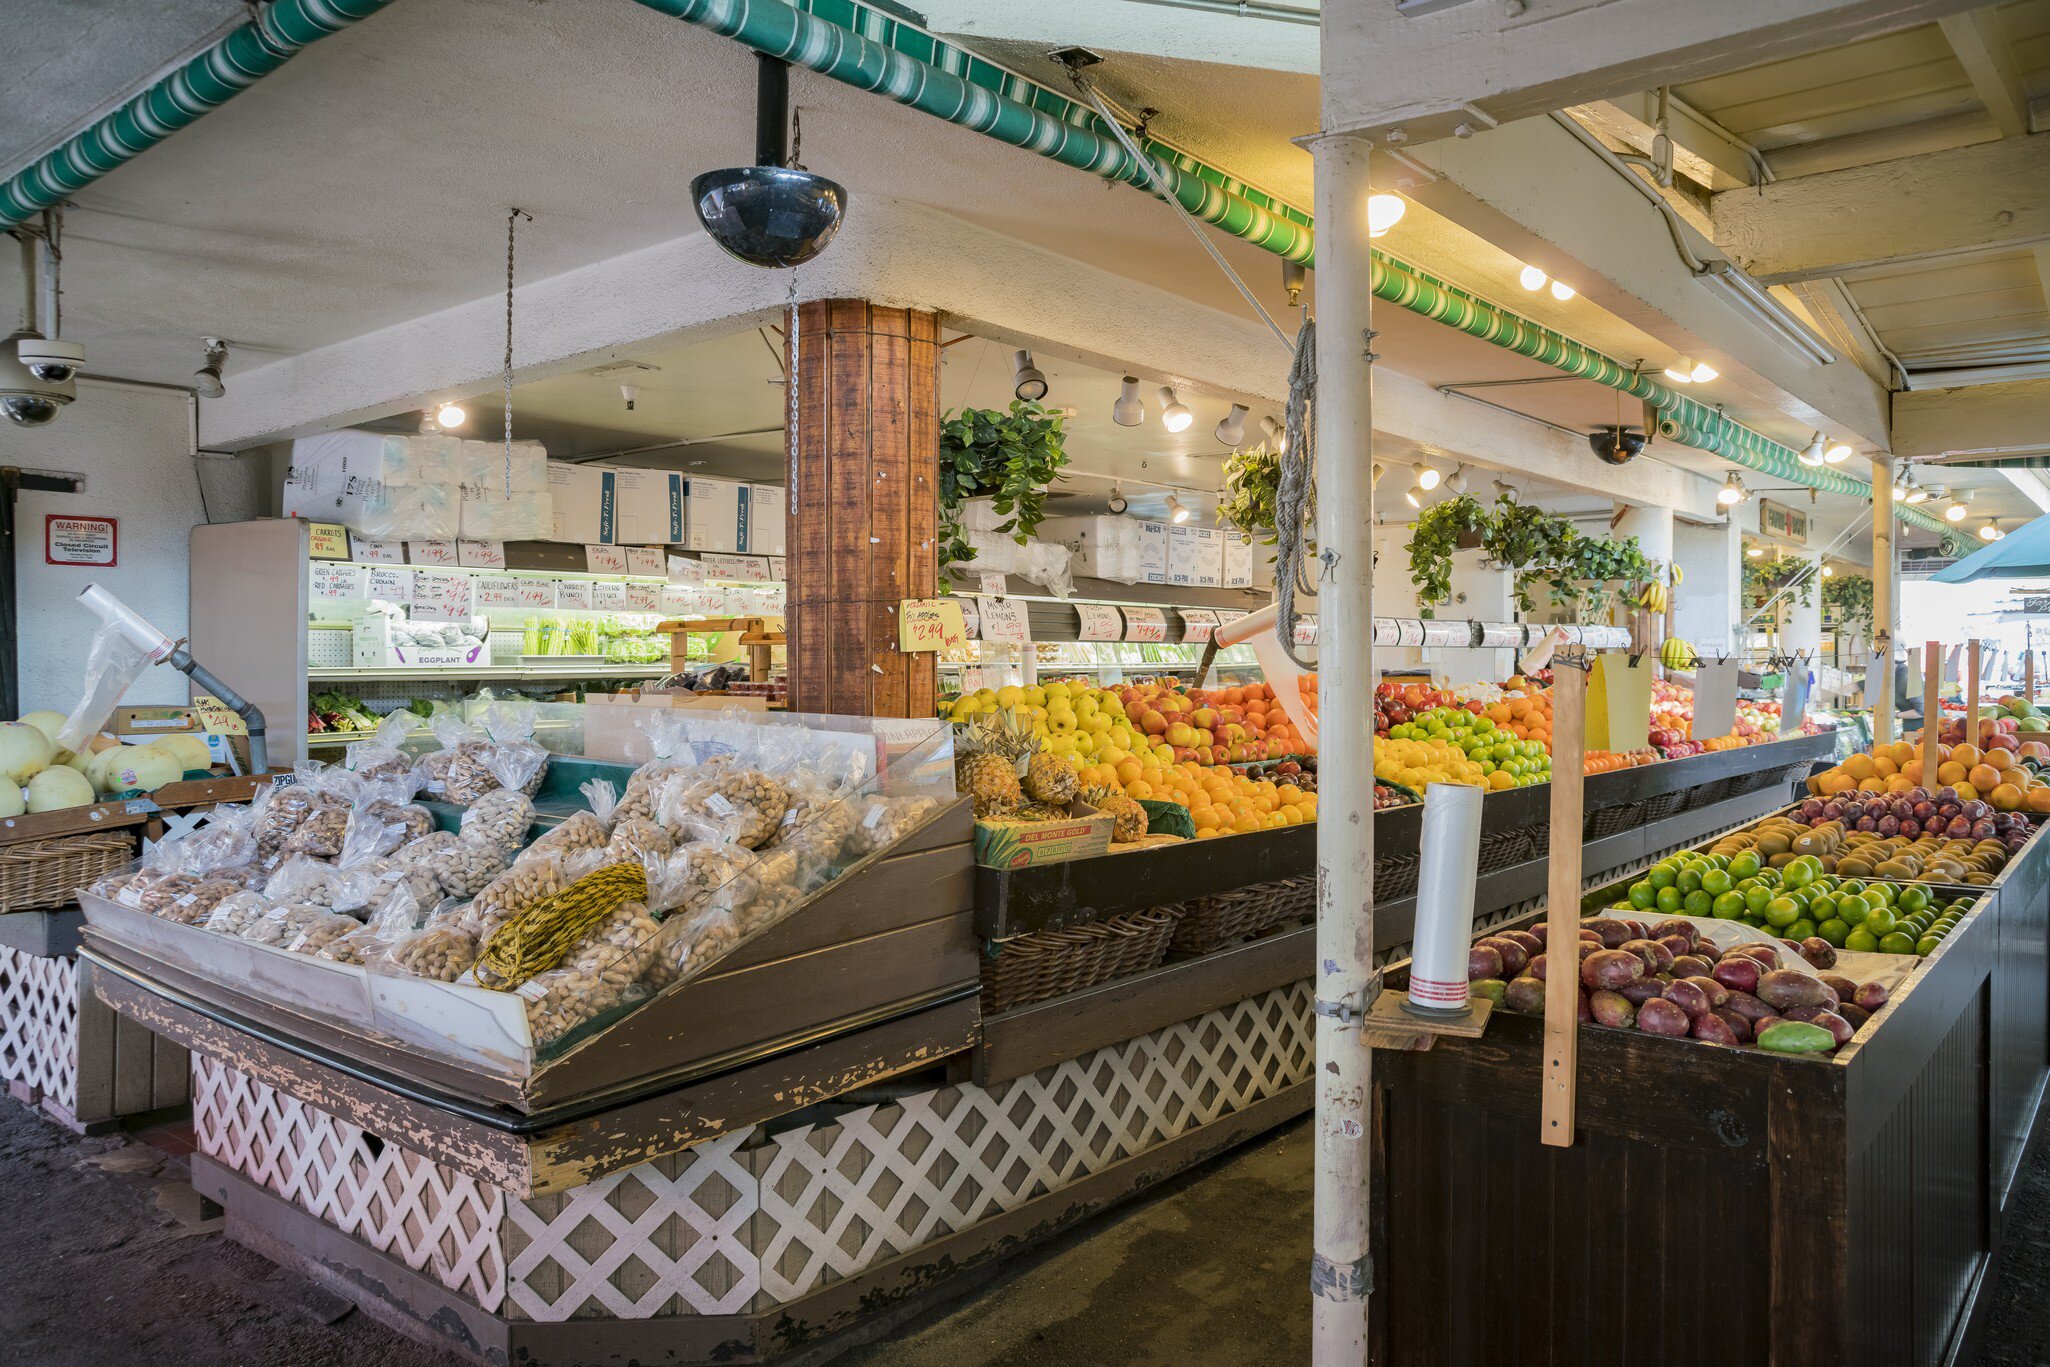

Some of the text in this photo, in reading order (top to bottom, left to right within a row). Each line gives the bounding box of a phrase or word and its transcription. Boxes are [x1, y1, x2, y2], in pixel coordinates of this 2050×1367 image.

[346, 475, 356, 496] 17S
[56, 521, 108, 532] WARNING!
[316, 529, 341, 537] CARROTS
[314, 568, 356, 577] GREEN CABBAGES
[477, 580, 518, 590] CAULIFLOWERS
[558, 583, 586, 591] CARROTS
[987, 601, 1012, 611] MEYER
[985, 610, 1017, 621] LEMONS
[1086, 610, 1112, 620] LEMONS
[1040, 830, 1065, 840] MONTE
[1067, 827, 1085, 836] GOLD
